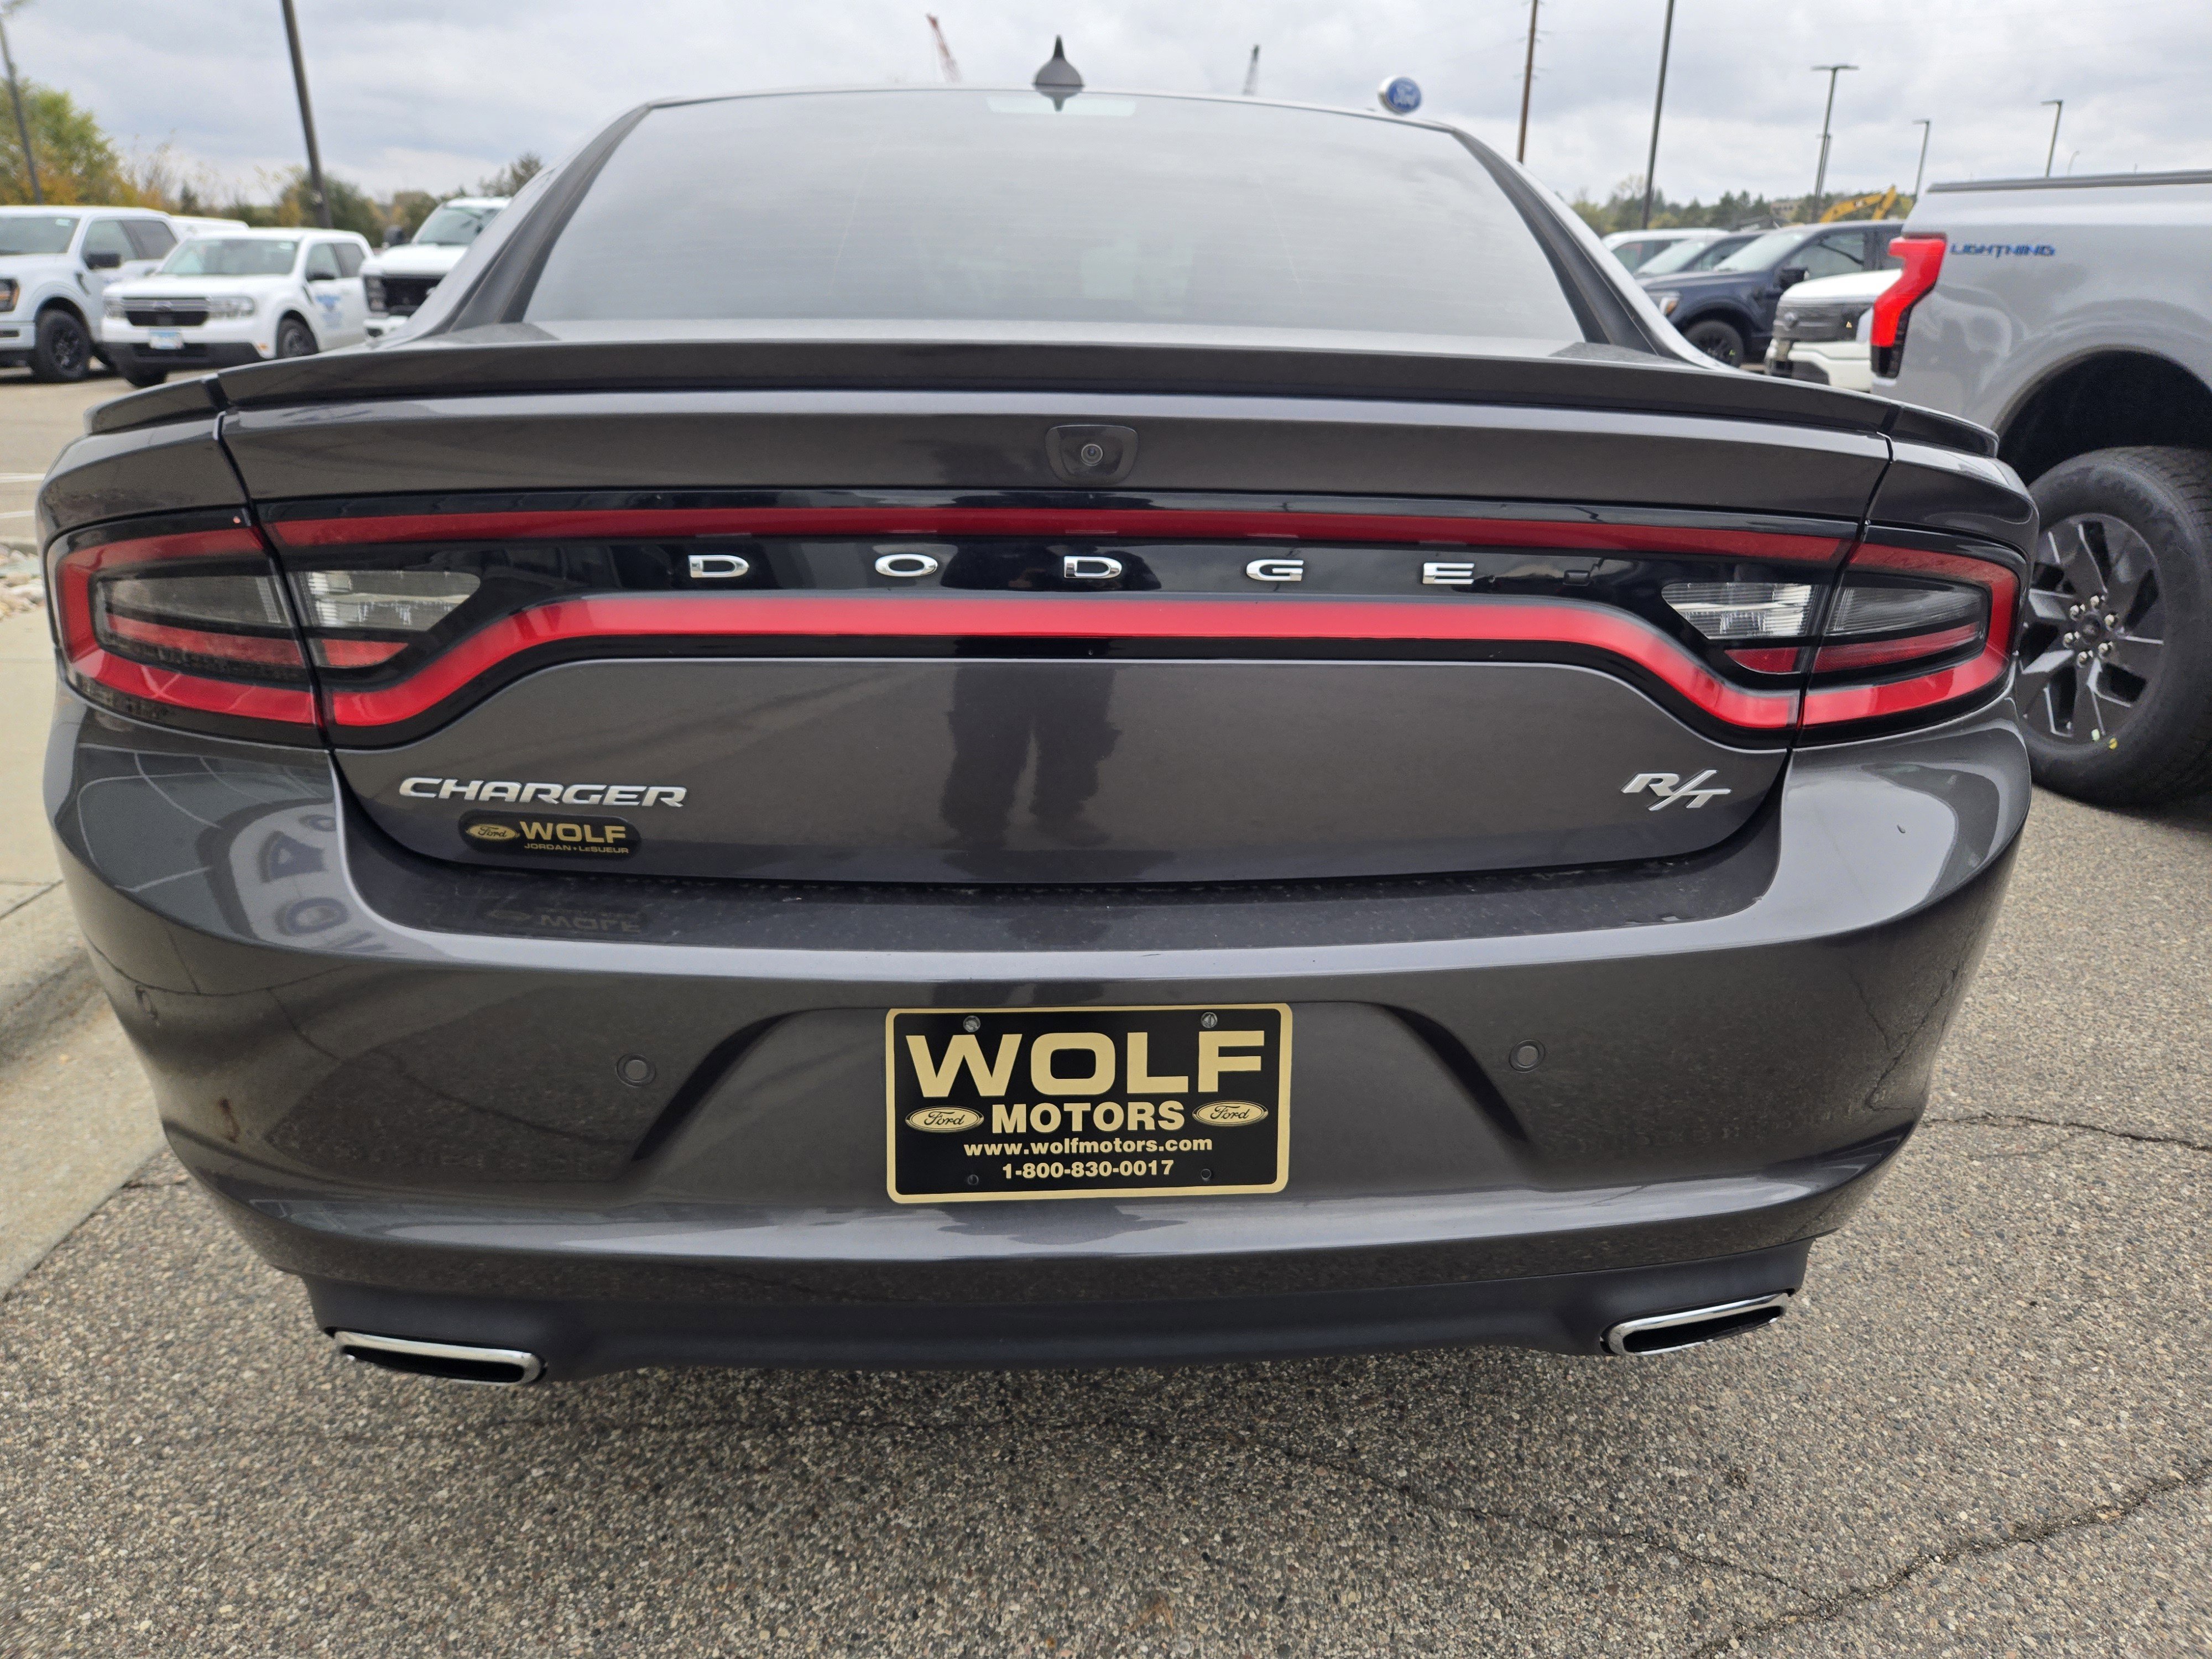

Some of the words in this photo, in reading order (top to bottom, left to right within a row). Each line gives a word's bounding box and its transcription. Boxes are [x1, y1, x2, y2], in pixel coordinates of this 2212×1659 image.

[688, 554, 1475, 585] DODGE
[399, 778, 687, 808] CHARGER
[1621, 769, 1731, 811] R/T
[478, 826, 508, 837] Ford
[519, 821, 626, 843] WOLF
[906, 1030, 1265, 1097] WOLF
[923, 1111, 965, 1126] Ford
[992, 1100, 1185, 1134] MOTORS
[1210, 1104, 1250, 1120] Ford
[964, 1137, 1213, 1156] www.wolfmotors.com
[1003, 1160, 1174, 1179] 1-800-830-0017
